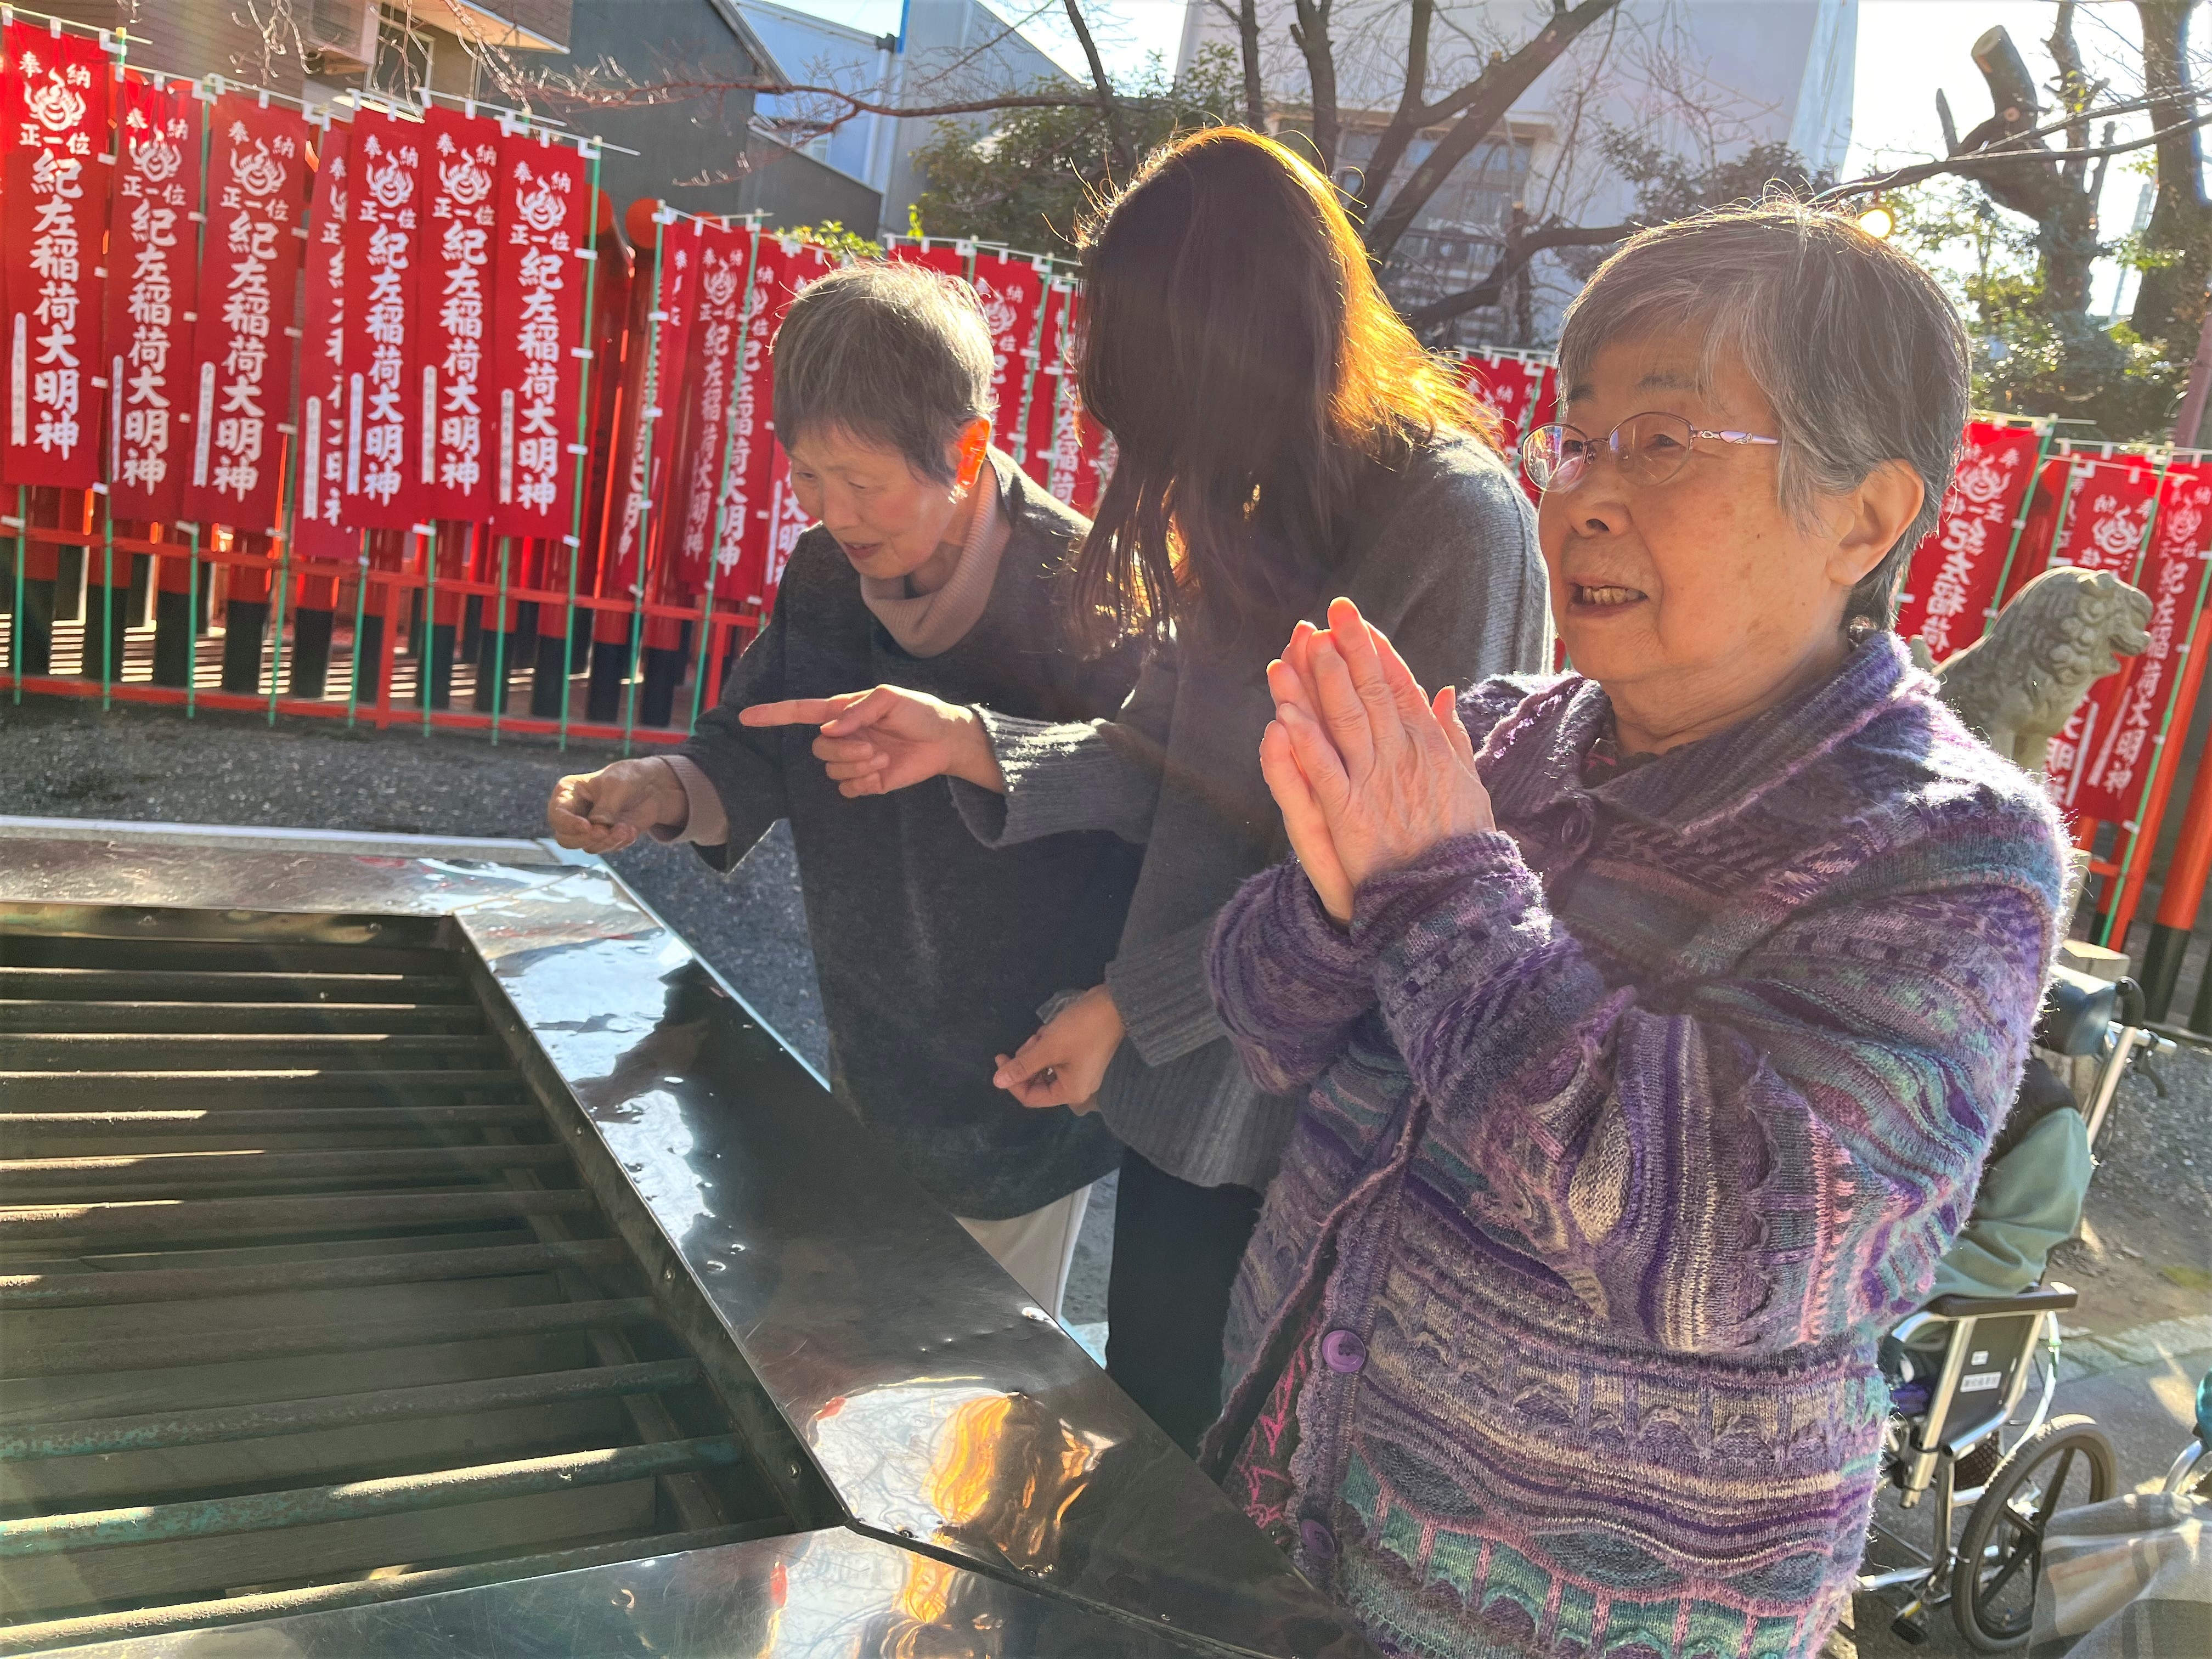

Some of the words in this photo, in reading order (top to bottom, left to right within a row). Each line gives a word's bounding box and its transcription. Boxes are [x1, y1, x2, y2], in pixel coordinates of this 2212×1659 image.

[19, 50, 92, 93] 奉納
[19, 122, 91, 156] 正一位
[126, 108, 189, 140] 奉納
[228, 120, 295, 159] 奉納
[364, 134, 419, 168] 奉納
[436, 132, 497, 166] 奉納
[121, 174, 186, 206] 正一位
[514, 160, 572, 194] 奉納
[220, 185, 289, 222] 正一位
[359, 200, 416, 230] 正一位
[433, 196, 494, 226] 正一位
[509, 224, 571, 252] 正一位
[30, 148, 83, 460] 紀左稲荷大明神
[122, 200, 177, 495] 紀左稲荷大明神
[212, 211, 279, 502] 紀左稲荷大明神
[439, 220, 488, 496] 紀左稲荷大明神
[363, 224, 410, 507] 紀左稲荷大明神
[517, 246, 564, 517] 紀左稲荷大明神
